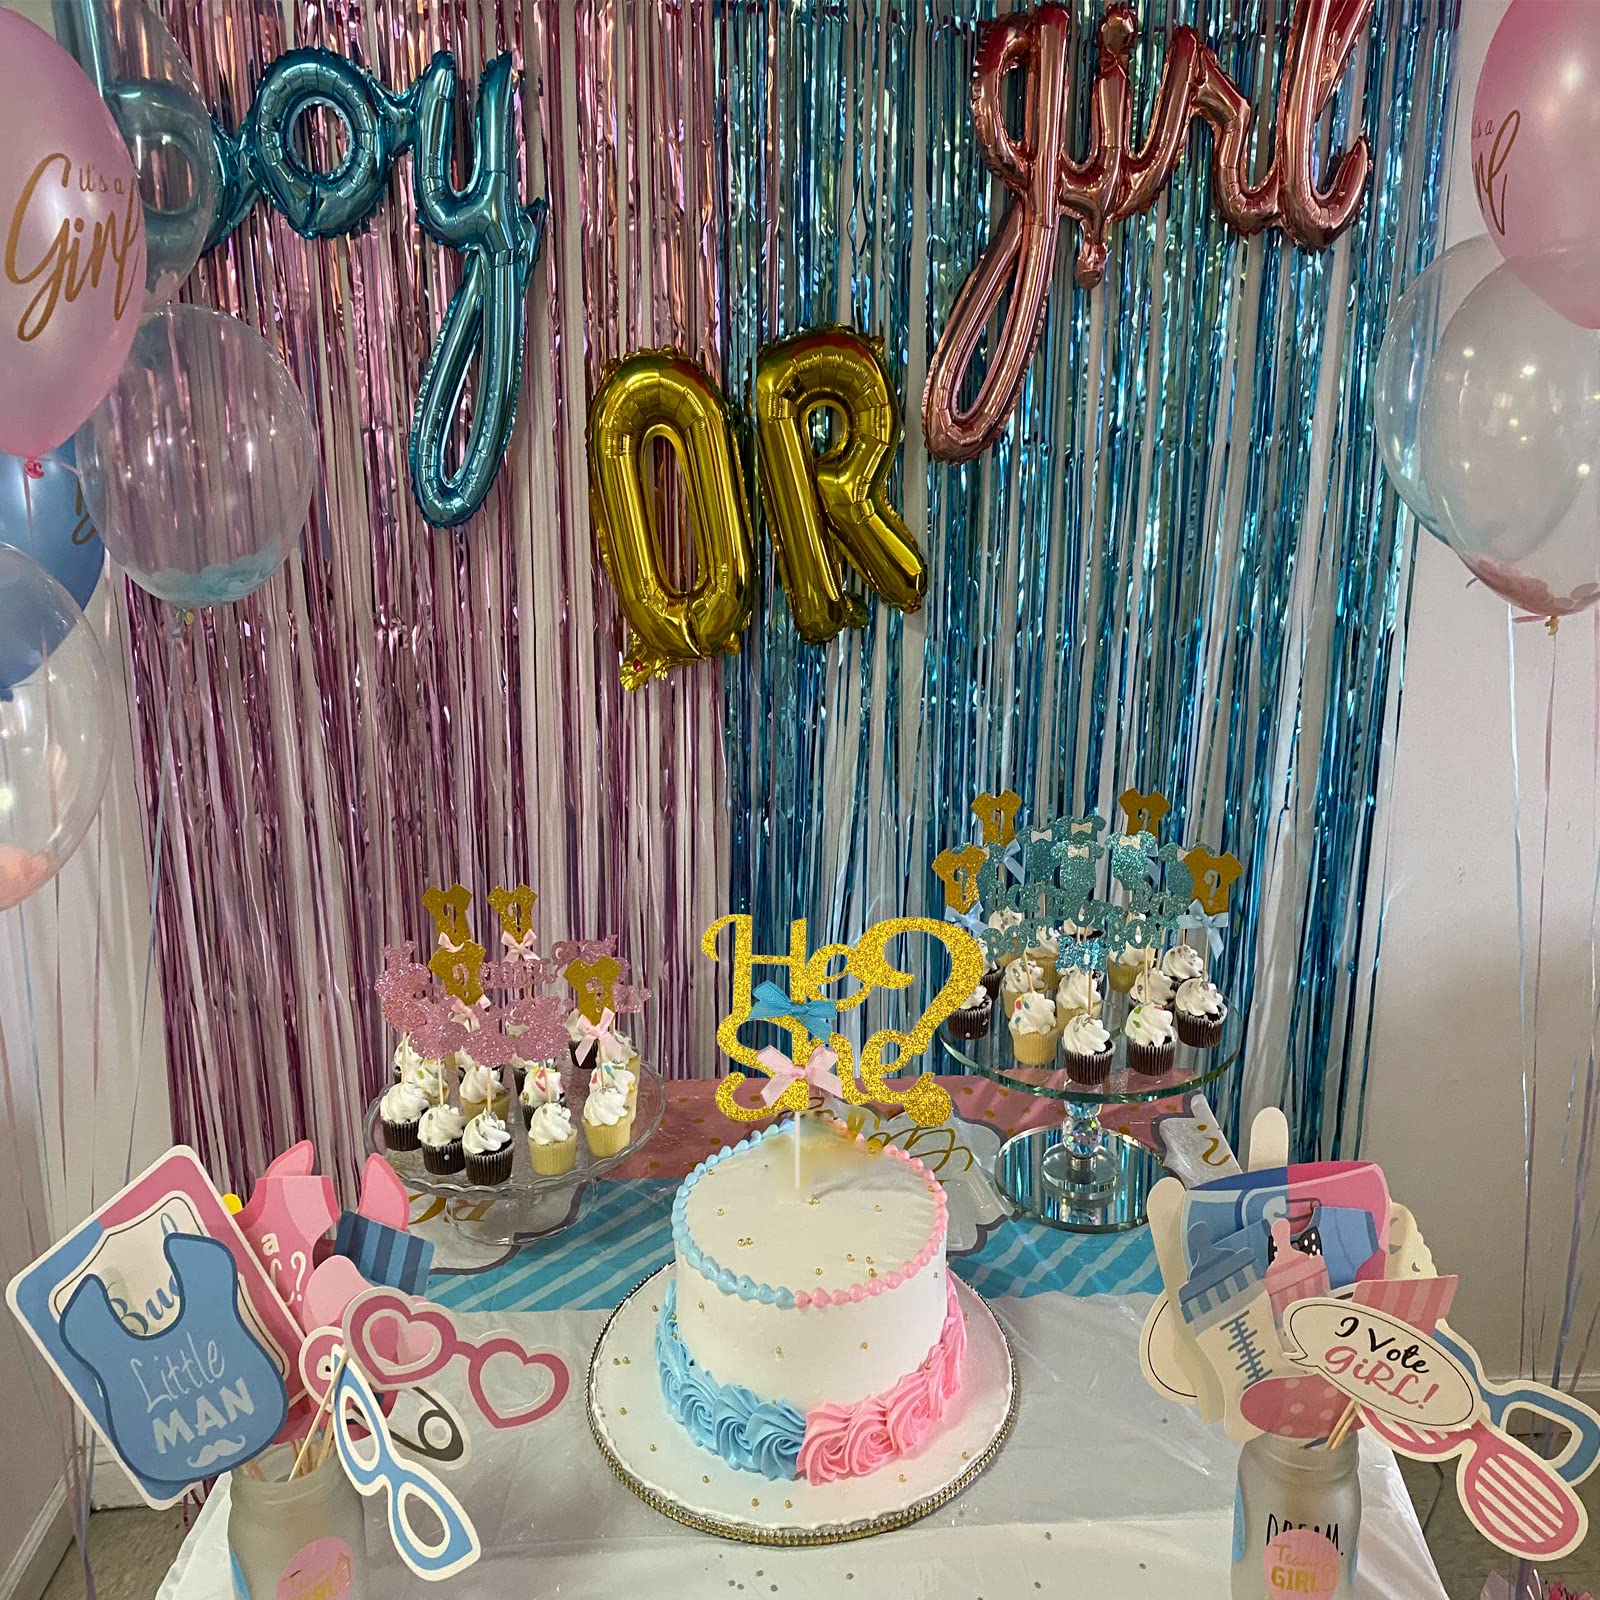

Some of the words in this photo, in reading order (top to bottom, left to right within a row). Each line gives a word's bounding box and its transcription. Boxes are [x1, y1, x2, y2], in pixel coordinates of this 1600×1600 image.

[5, 152, 141, 342] Girl
[921, 0, 1374, 464] girl
[587, 322, 928, 693] OR
[130, 1331, 225, 1414] Little
[1368, 1328, 1430, 1374] Vote
[152, 1376, 255, 1454] MAN
[1271, 1565, 1329, 1593] GIRL
